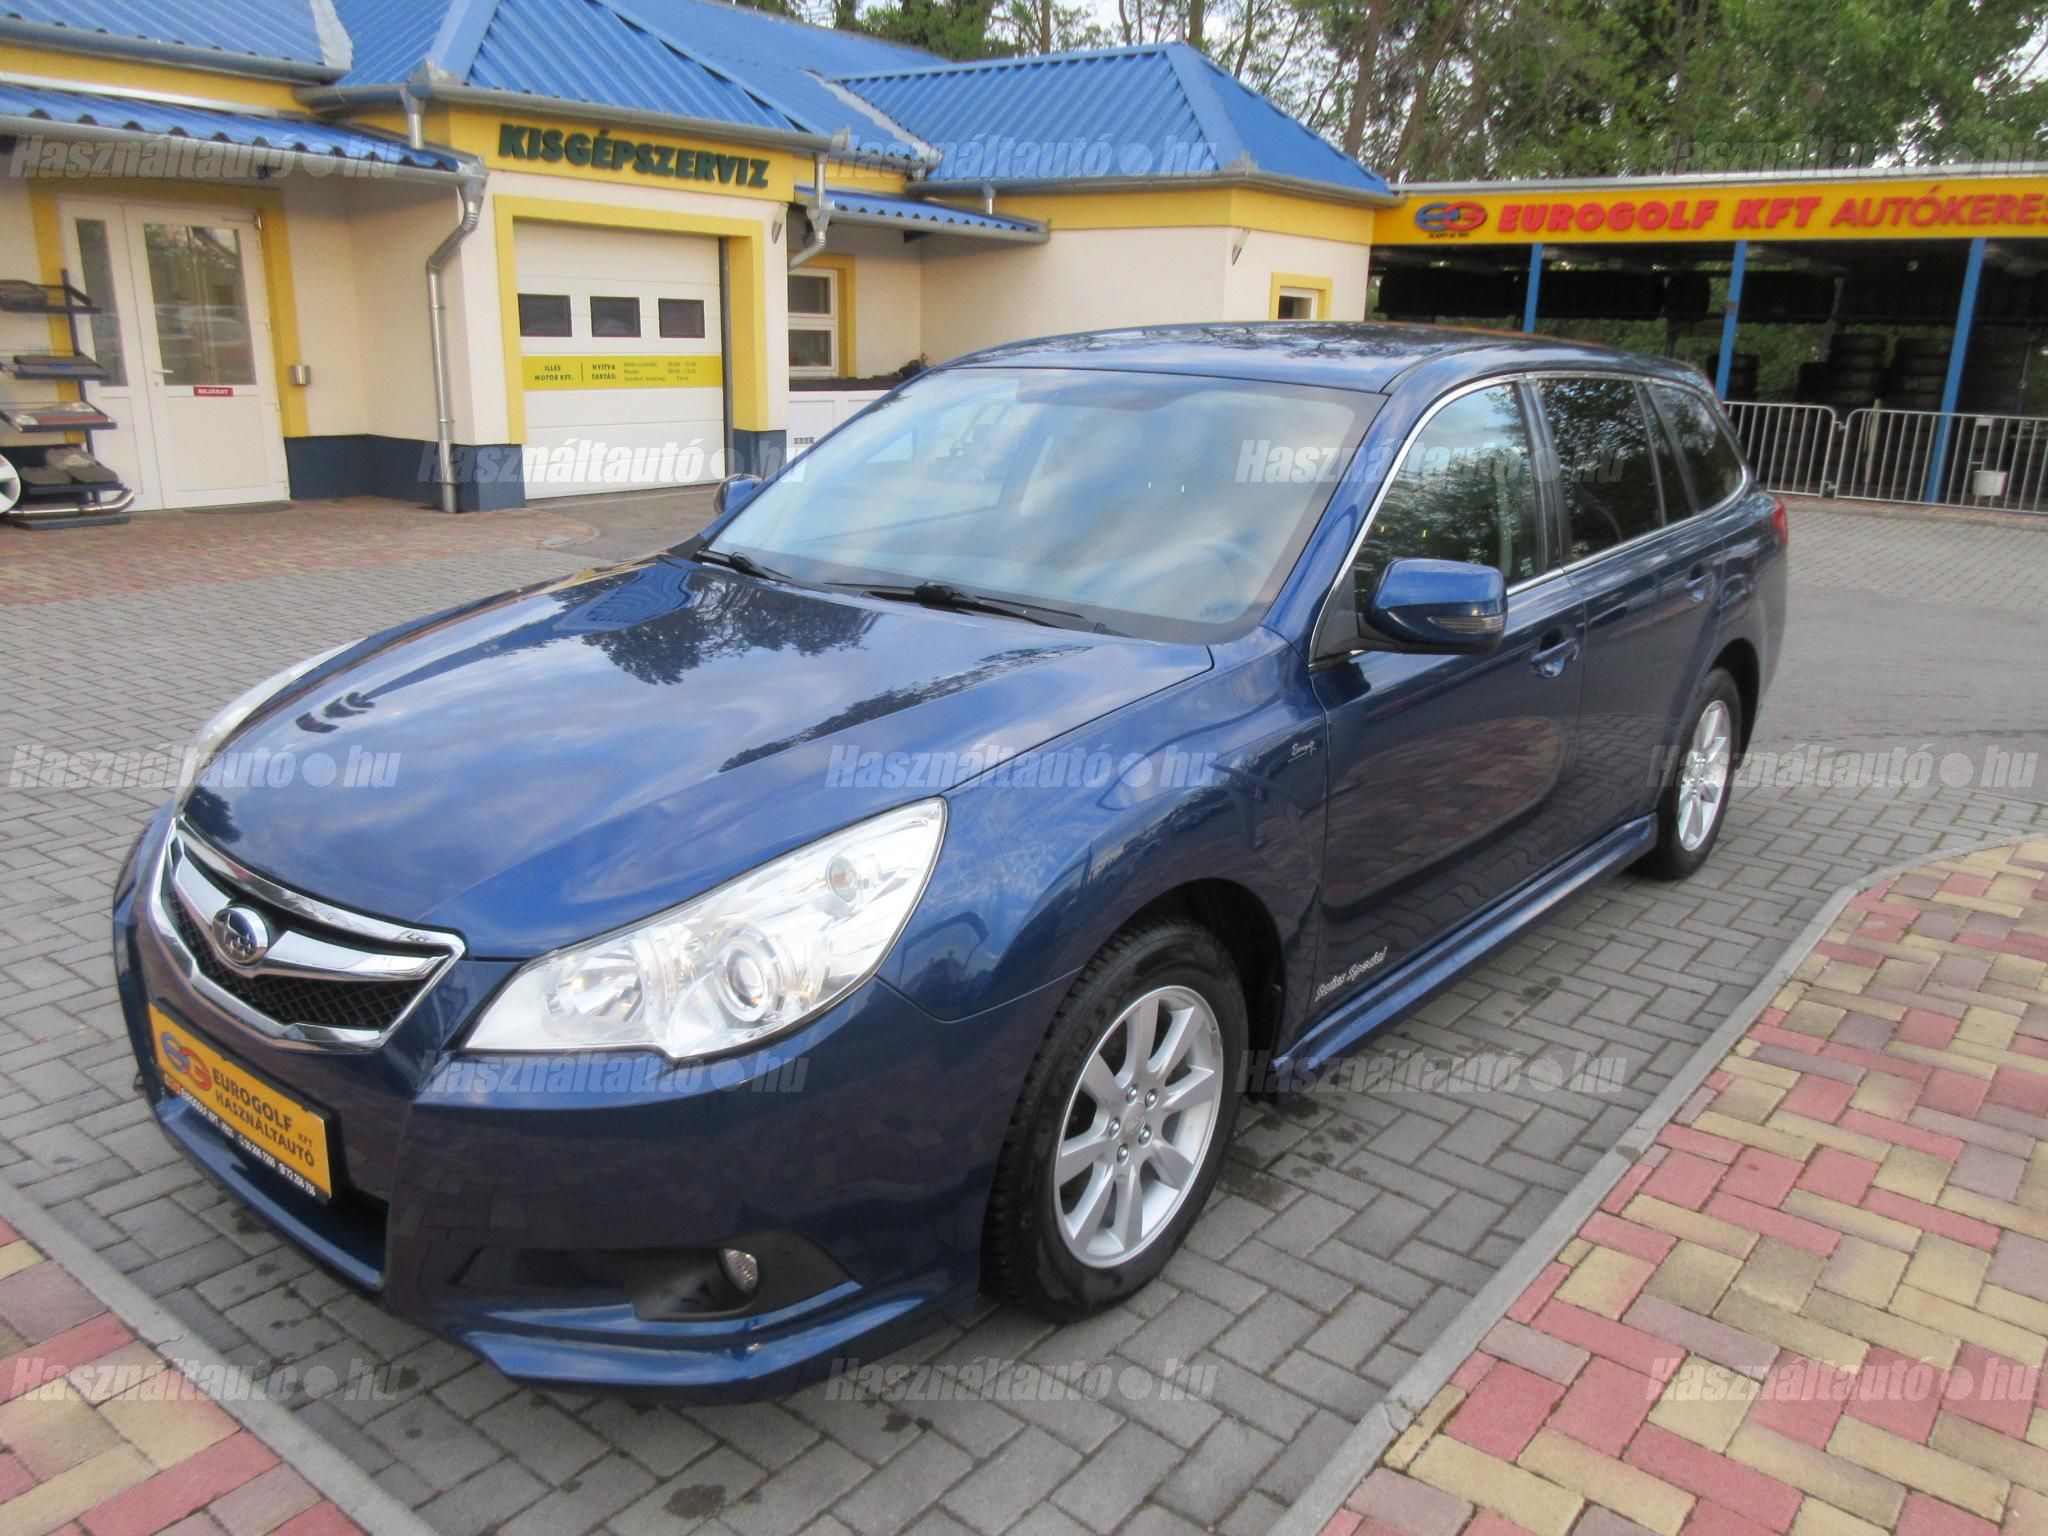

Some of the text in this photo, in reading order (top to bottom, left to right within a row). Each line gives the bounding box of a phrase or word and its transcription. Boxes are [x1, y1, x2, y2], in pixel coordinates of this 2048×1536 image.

[499, 123, 770, 188] KISGÉPSZERVIZ
[1497, 185, 2048, 232] EUROGOLF KFT AUTÓKERE
[212, 1067, 292, 1131] EUROGOLF
